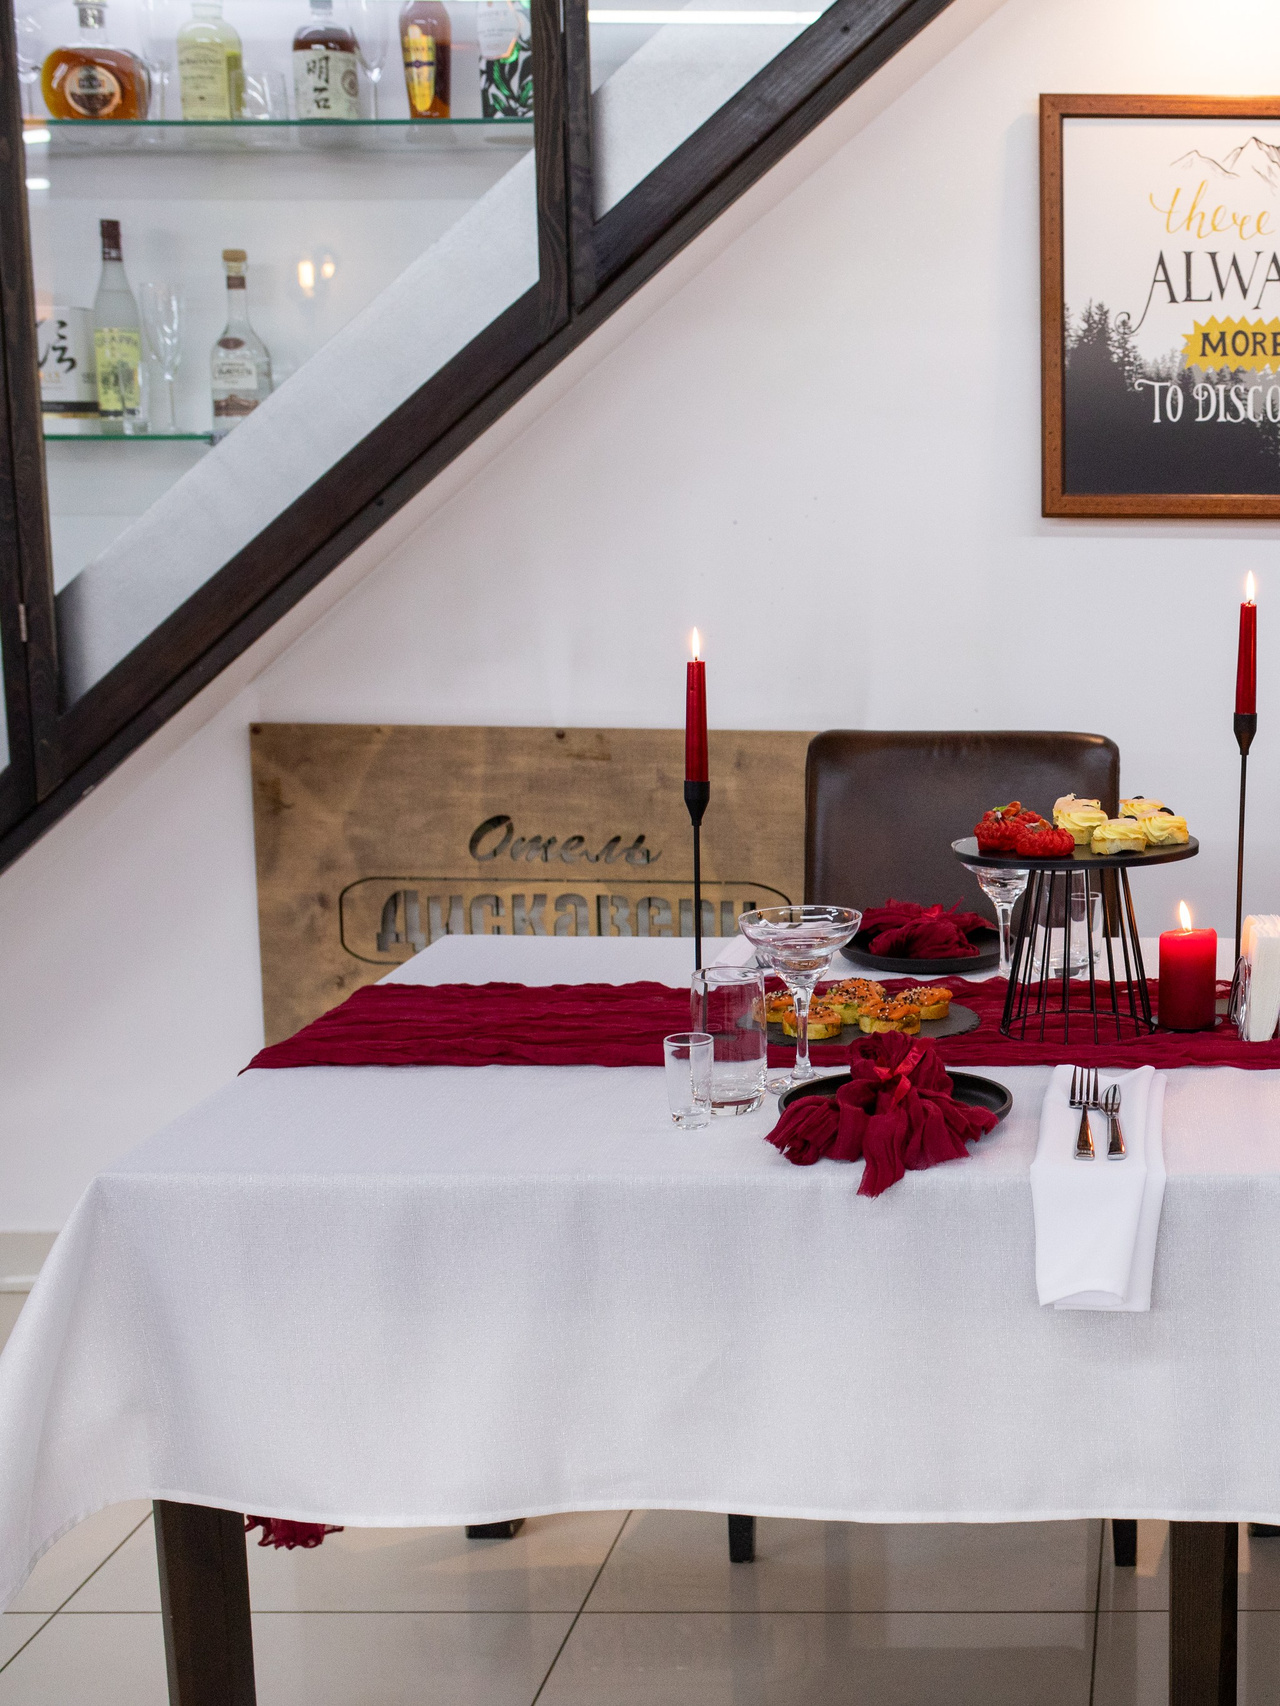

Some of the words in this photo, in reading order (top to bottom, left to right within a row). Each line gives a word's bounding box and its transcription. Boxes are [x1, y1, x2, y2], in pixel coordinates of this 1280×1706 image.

[1149, 179, 1275, 240] there
[1134, 378, 1184, 423] TO
[468, 814, 663, 865] Отель
